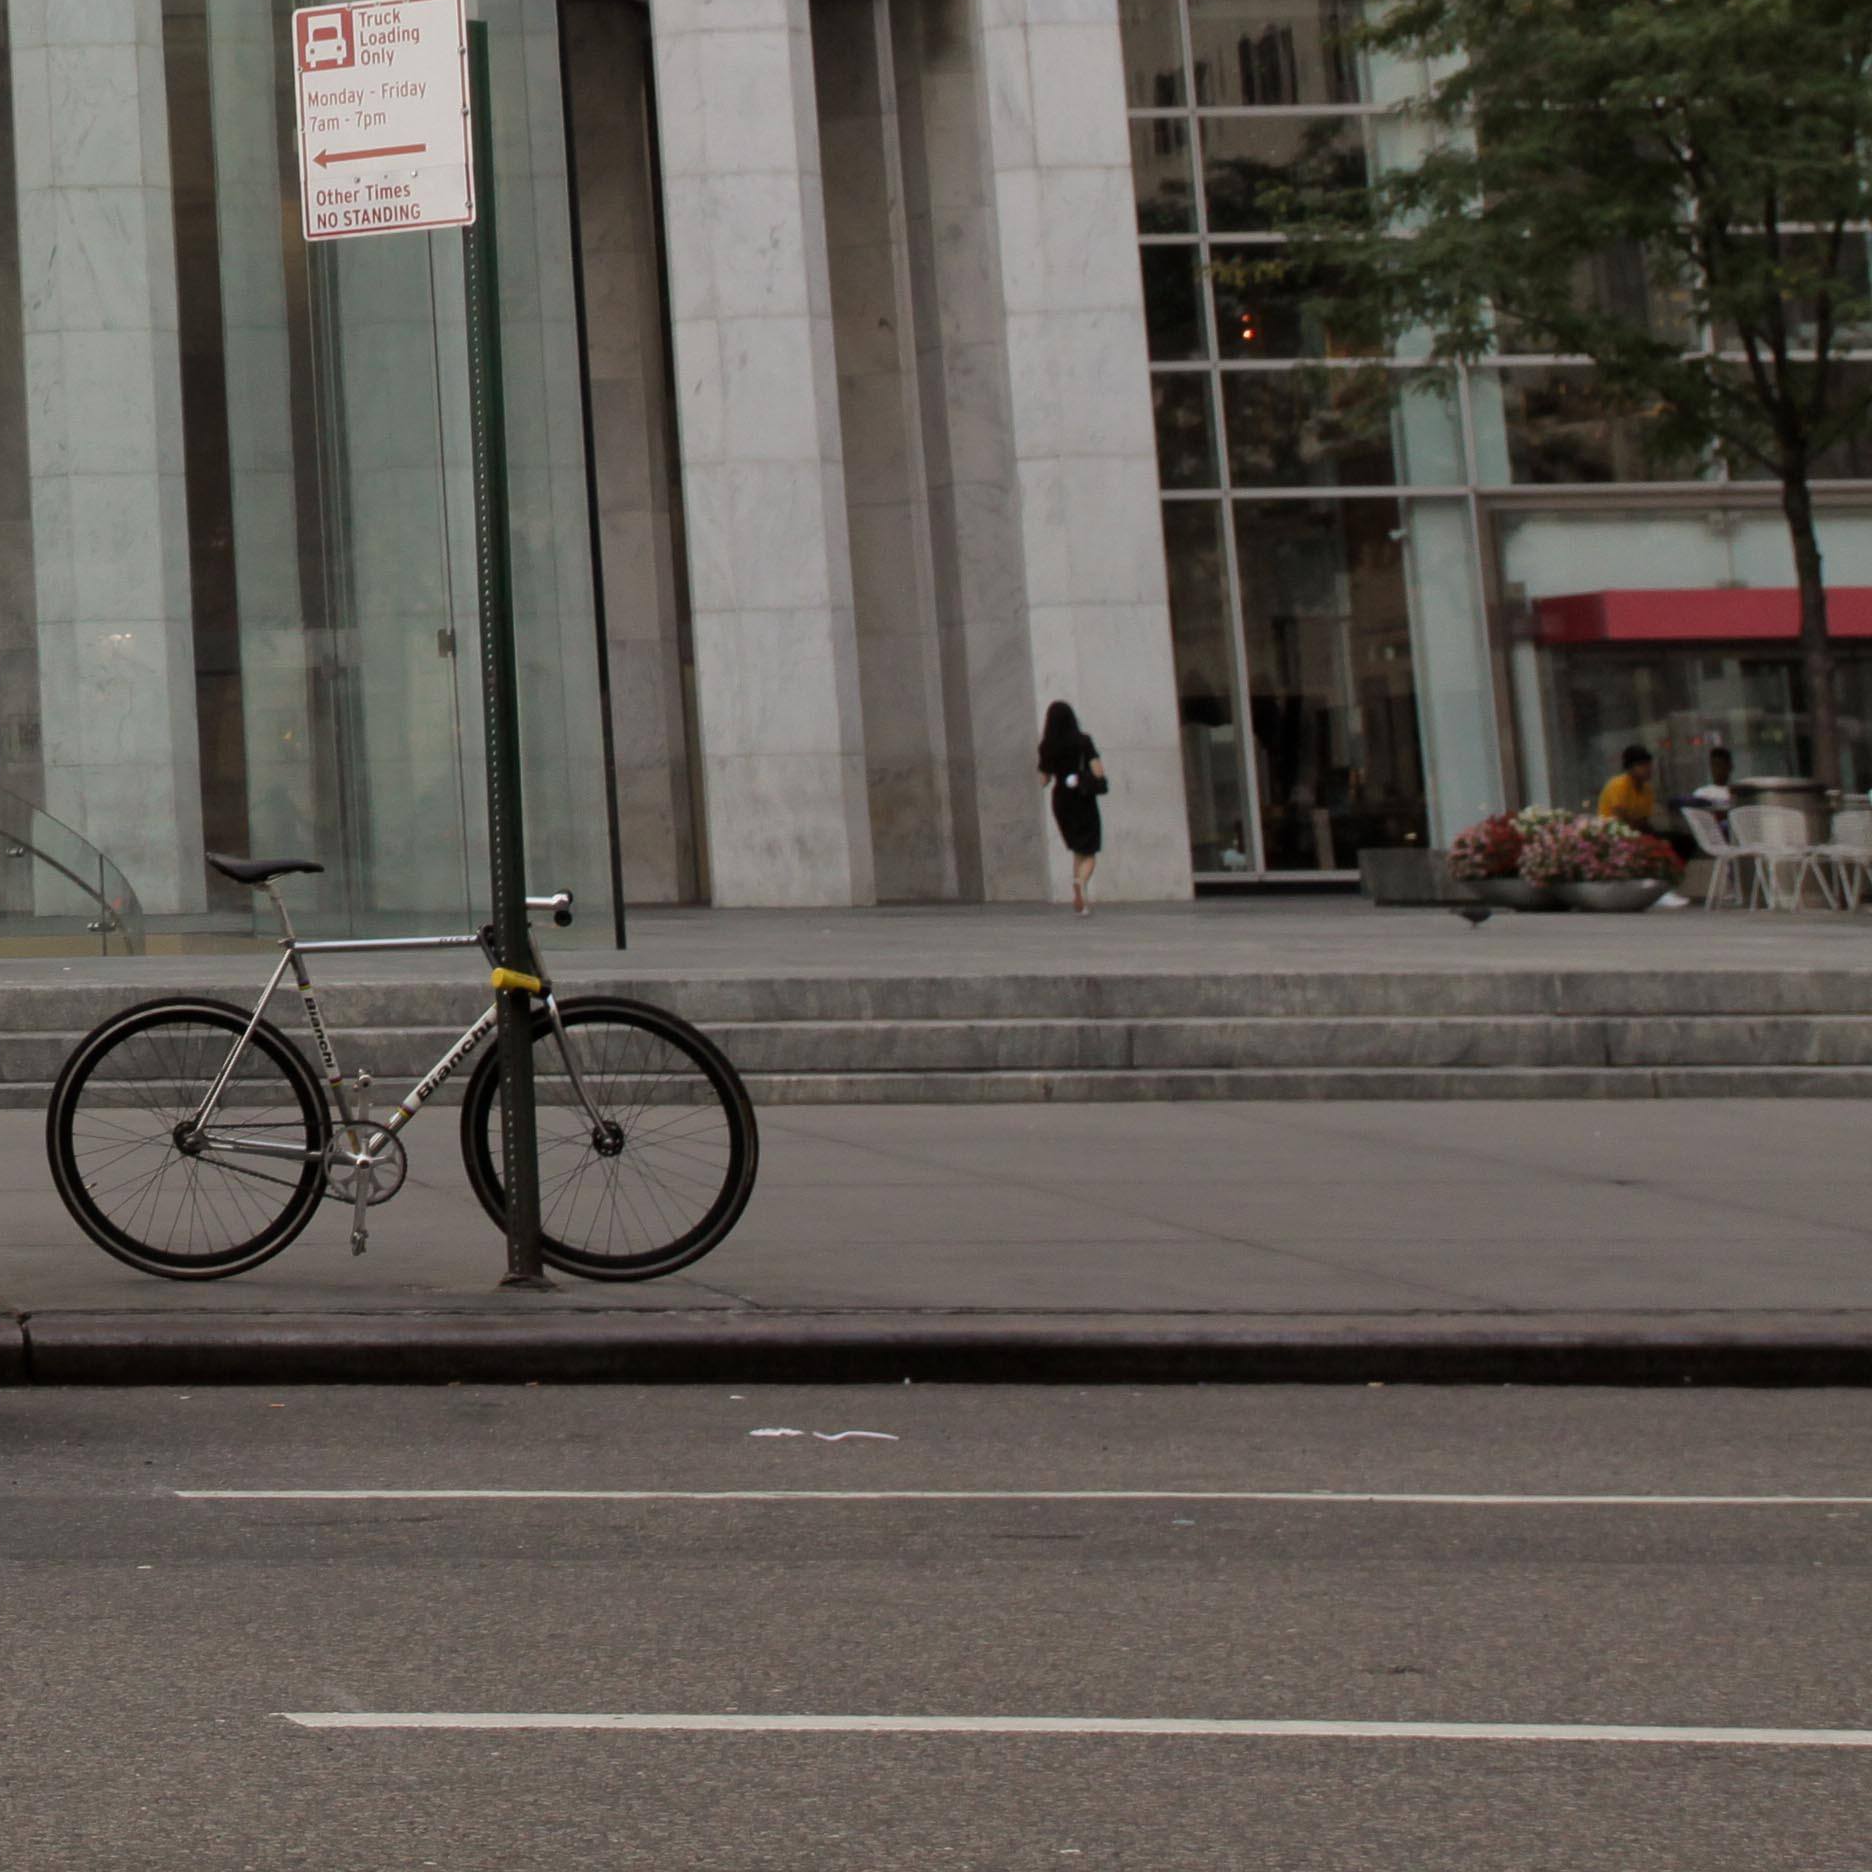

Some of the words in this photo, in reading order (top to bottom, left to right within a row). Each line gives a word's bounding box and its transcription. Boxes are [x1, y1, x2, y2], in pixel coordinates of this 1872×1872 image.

[358, 8, 401, 28] Truck
[360, 26, 420, 46] Loading
[360, 48, 394, 67] Only
[308, 87, 365, 109] Monday
[381, 80, 427, 101] Friday
[309, 115, 340, 133] 7am
[355, 110, 387, 130] 7pm
[316, 187, 359, 207] Other
[365, 182, 411, 202] Times
[317, 210, 339, 229] NO
[343, 203, 421, 226] STANDING
